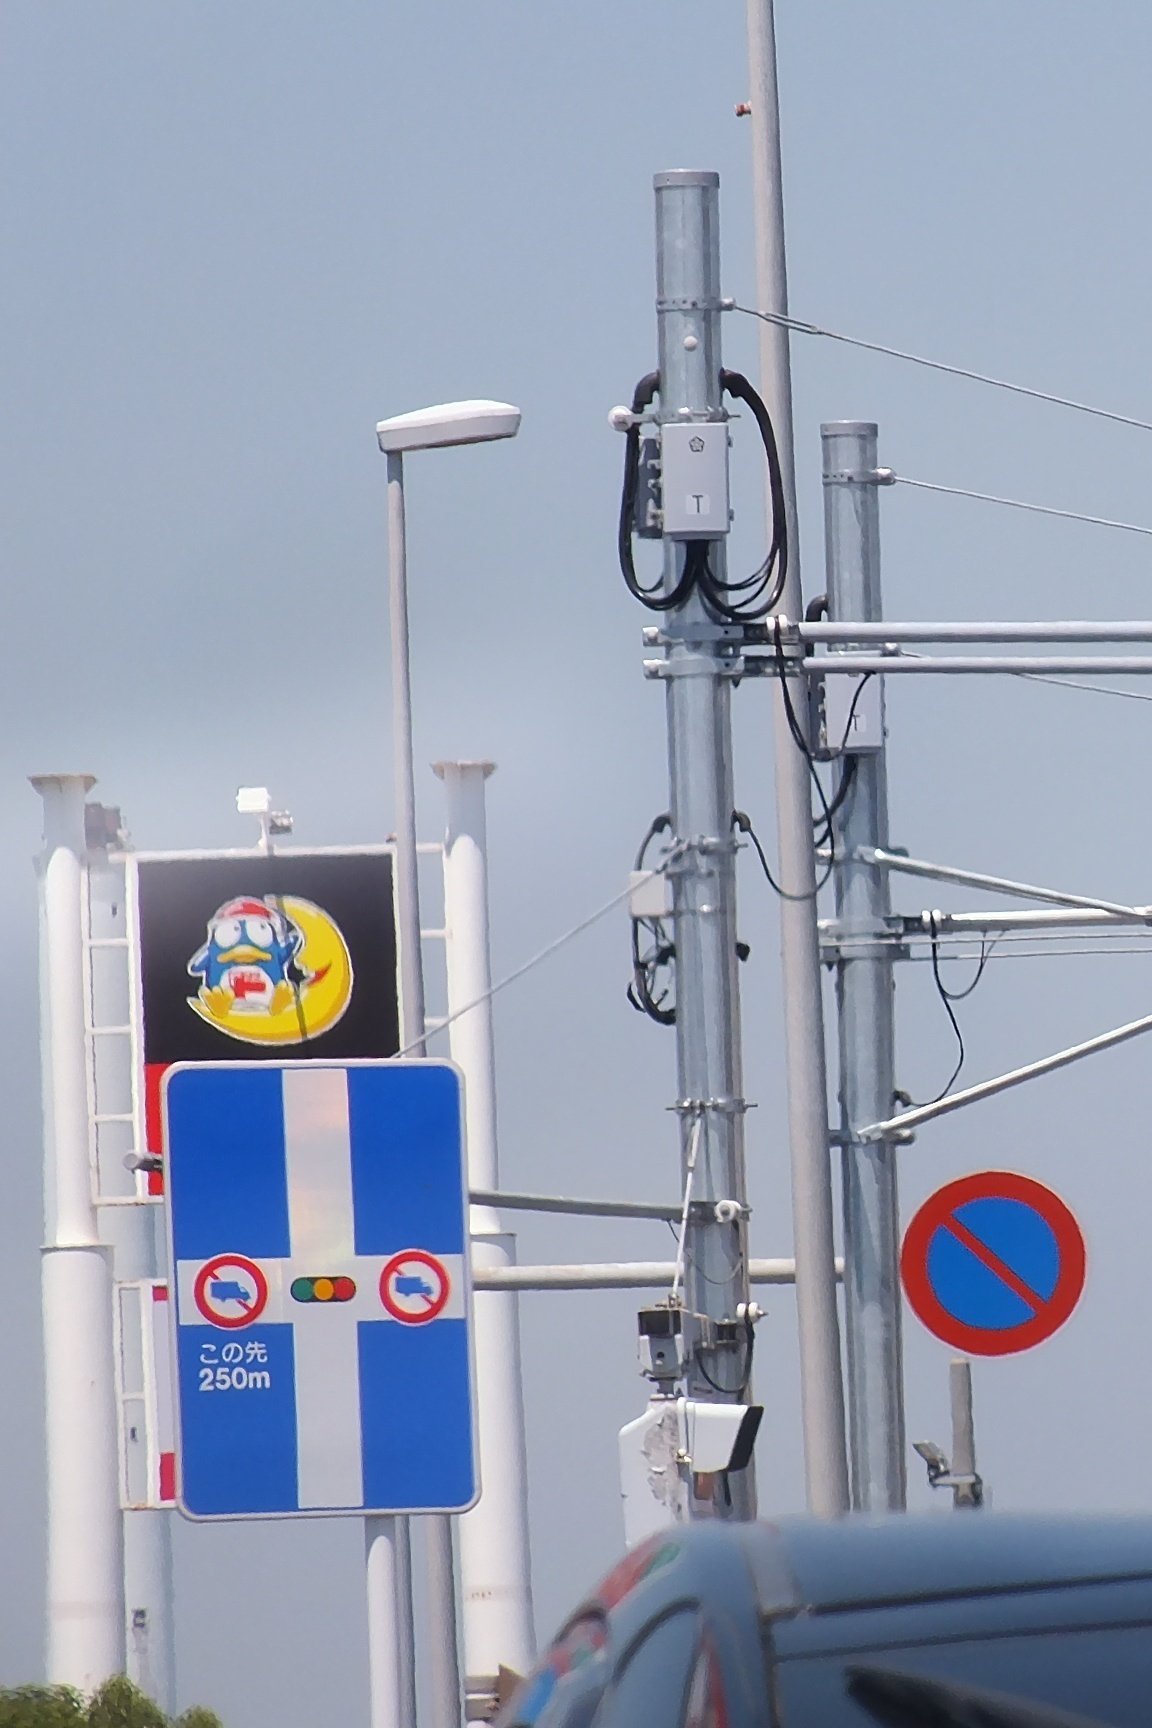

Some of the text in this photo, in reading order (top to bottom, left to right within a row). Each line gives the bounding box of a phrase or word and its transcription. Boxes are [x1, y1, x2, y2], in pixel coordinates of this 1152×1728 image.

[692, 495, 704, 513] T
[199, 1341, 268, 1364] この先
[199, 1367, 271, 1392] 250m
